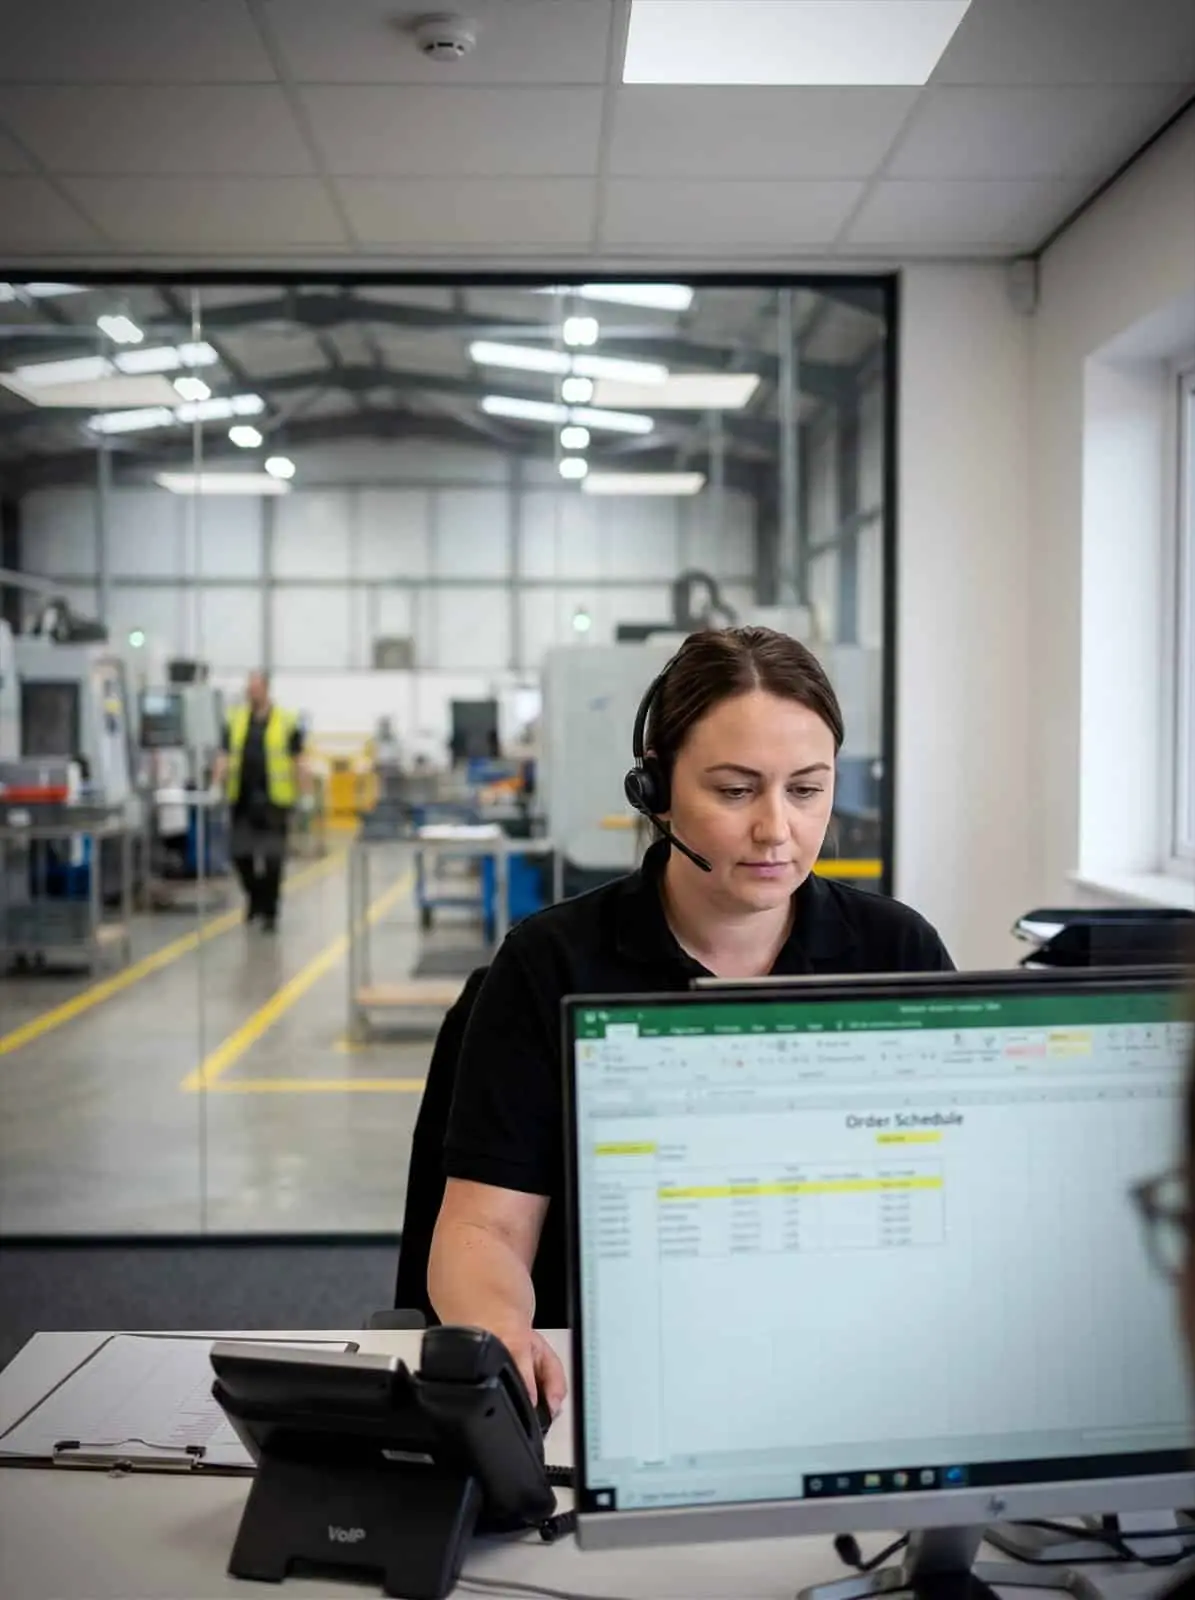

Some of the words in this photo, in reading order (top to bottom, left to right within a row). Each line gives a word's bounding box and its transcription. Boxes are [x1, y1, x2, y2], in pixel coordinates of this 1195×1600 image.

[846, 1113, 890, 1129] Order
[894, 1110, 964, 1128] Schedule
[328, 1524, 366, 1543] VoIP
